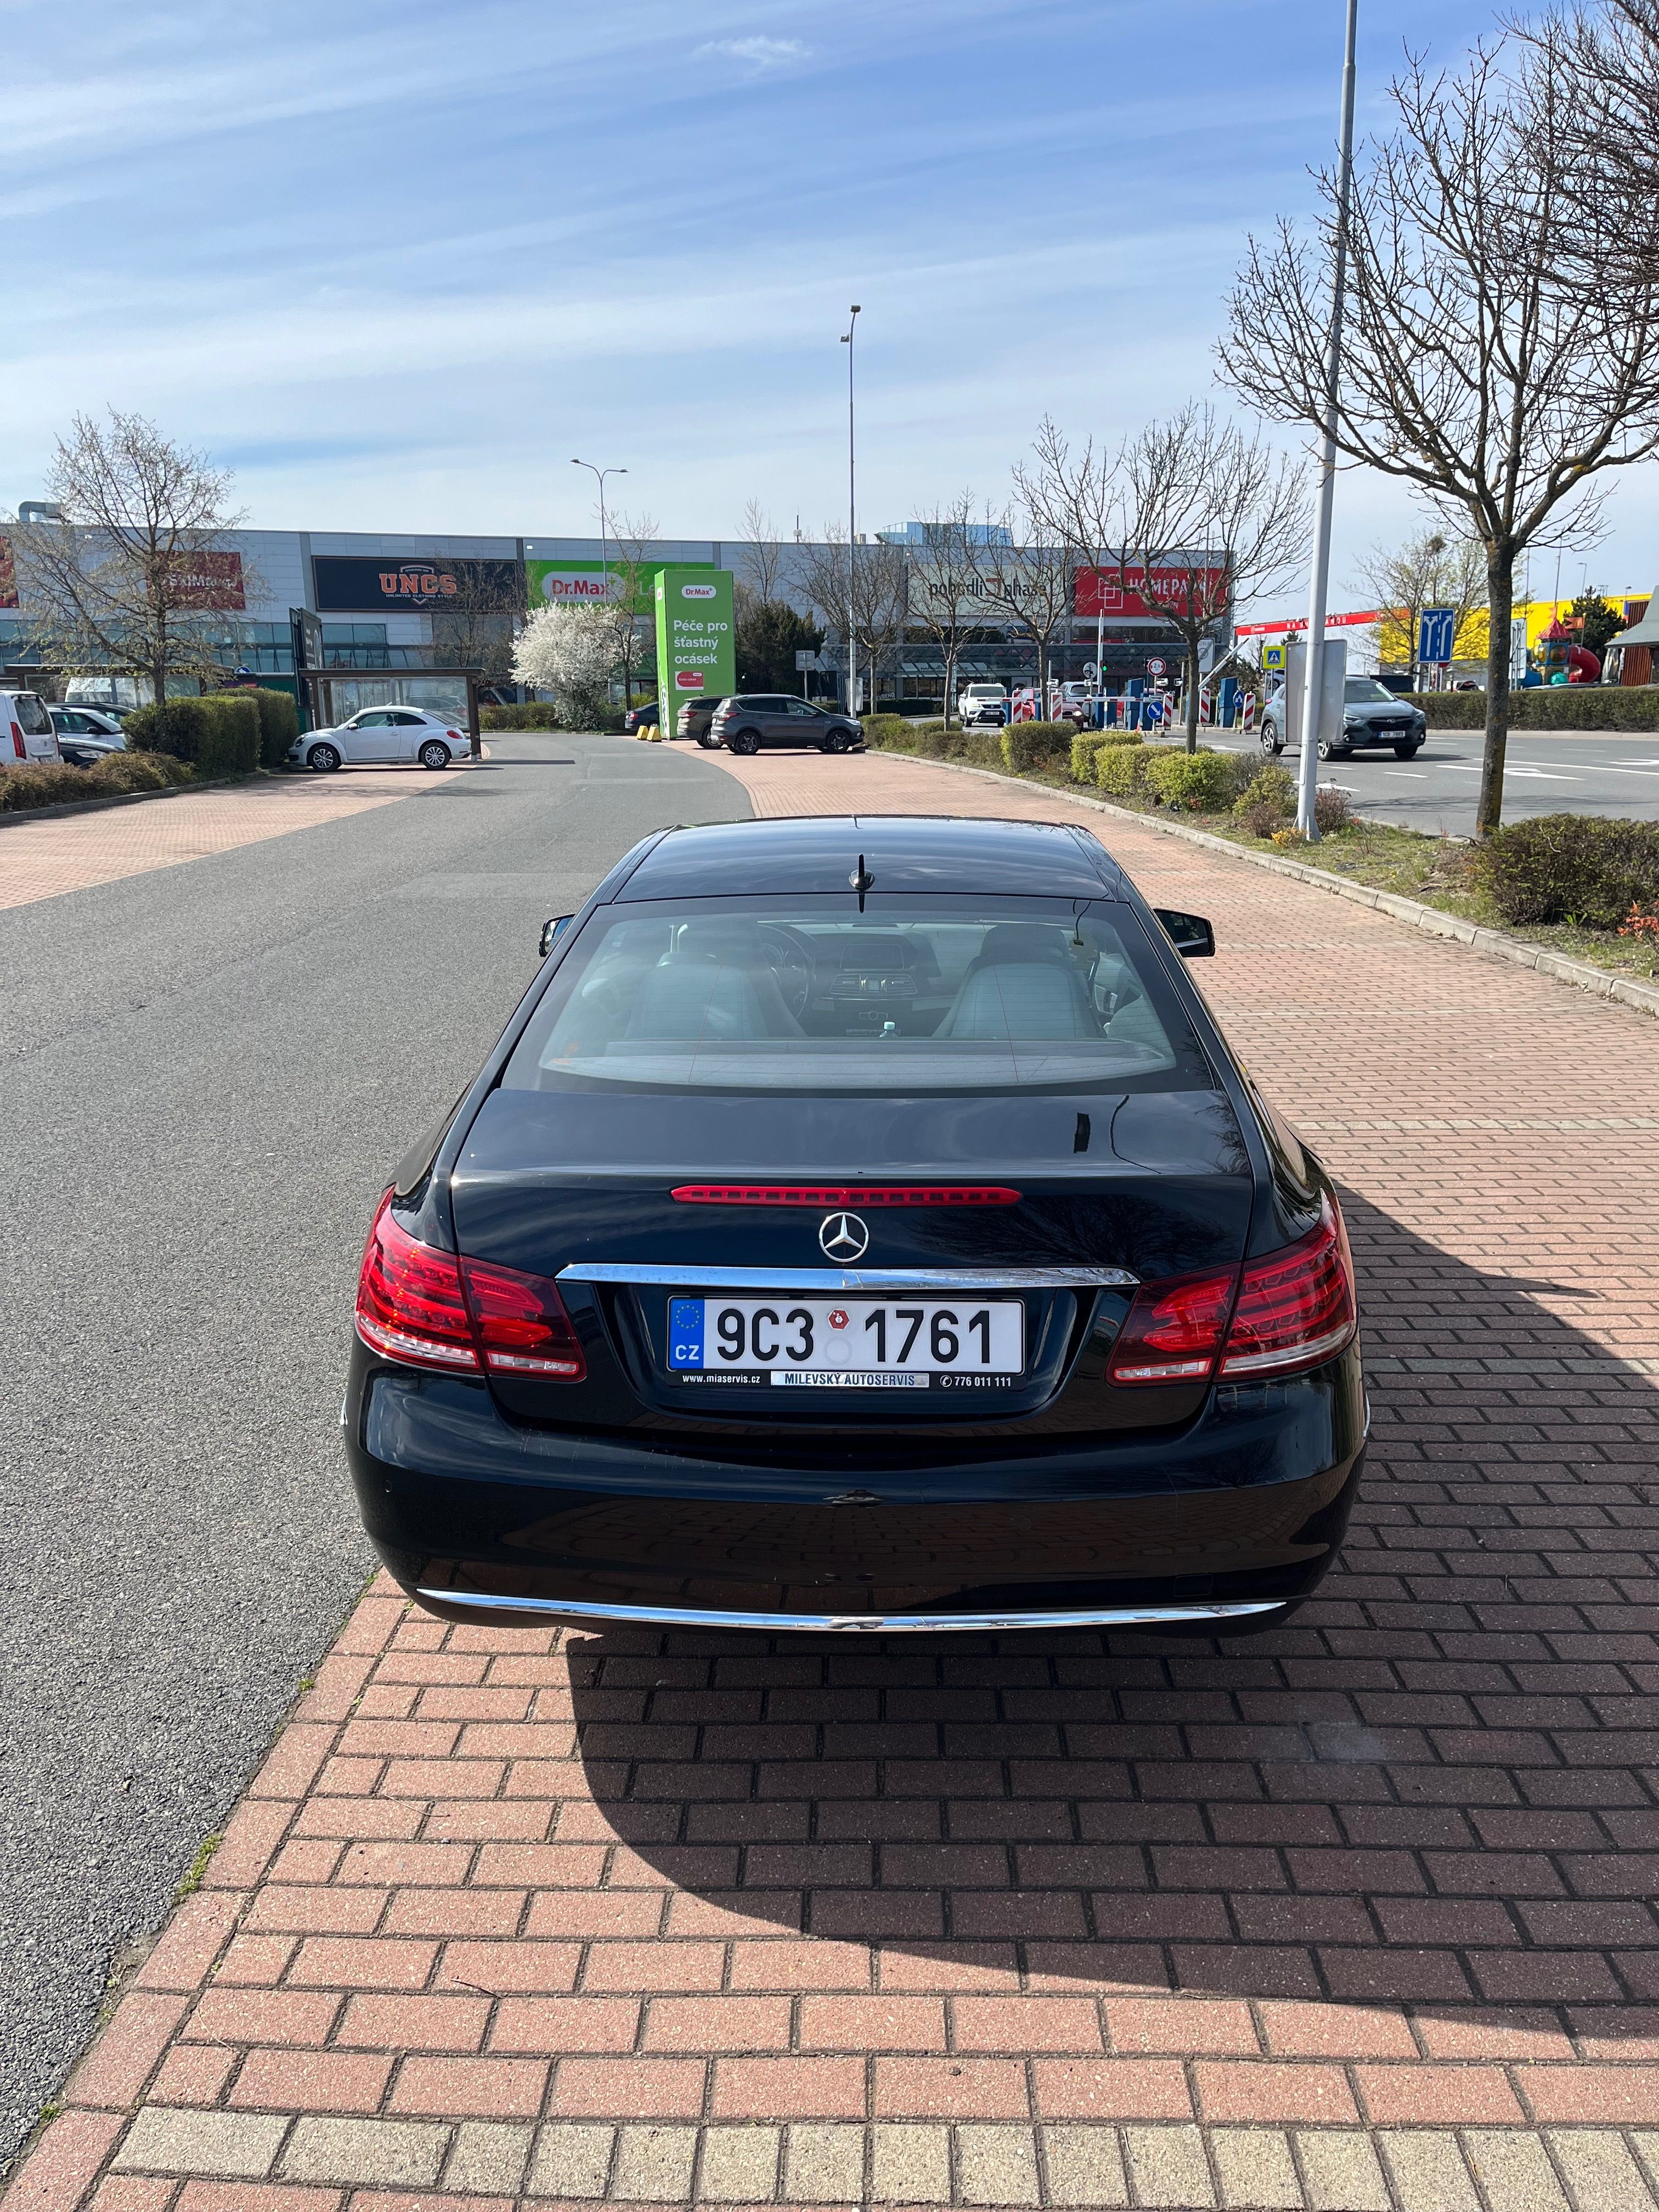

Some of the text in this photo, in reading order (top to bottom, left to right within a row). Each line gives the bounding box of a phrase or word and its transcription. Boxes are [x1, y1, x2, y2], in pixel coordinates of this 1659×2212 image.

[379, 573, 457, 594] UNCS
[552, 580, 609, 595] Dr.Max
[1129, 578, 1206, 595] HOMEPAK
[674, 619, 728, 634] Péče pro
[674, 635, 719, 650] šťastný
[674, 652, 718, 664] ocásek
[717, 1308, 990, 1364] 9C3 1761
[675, 1345, 699, 1361] CZ
[682, 1374, 760, 1384] www.miaservis.cz
[785, 1372, 915, 1386] MILEVSKÝ AUTOSERVIS
[954, 1376, 1011, 1387] 776 011 111
